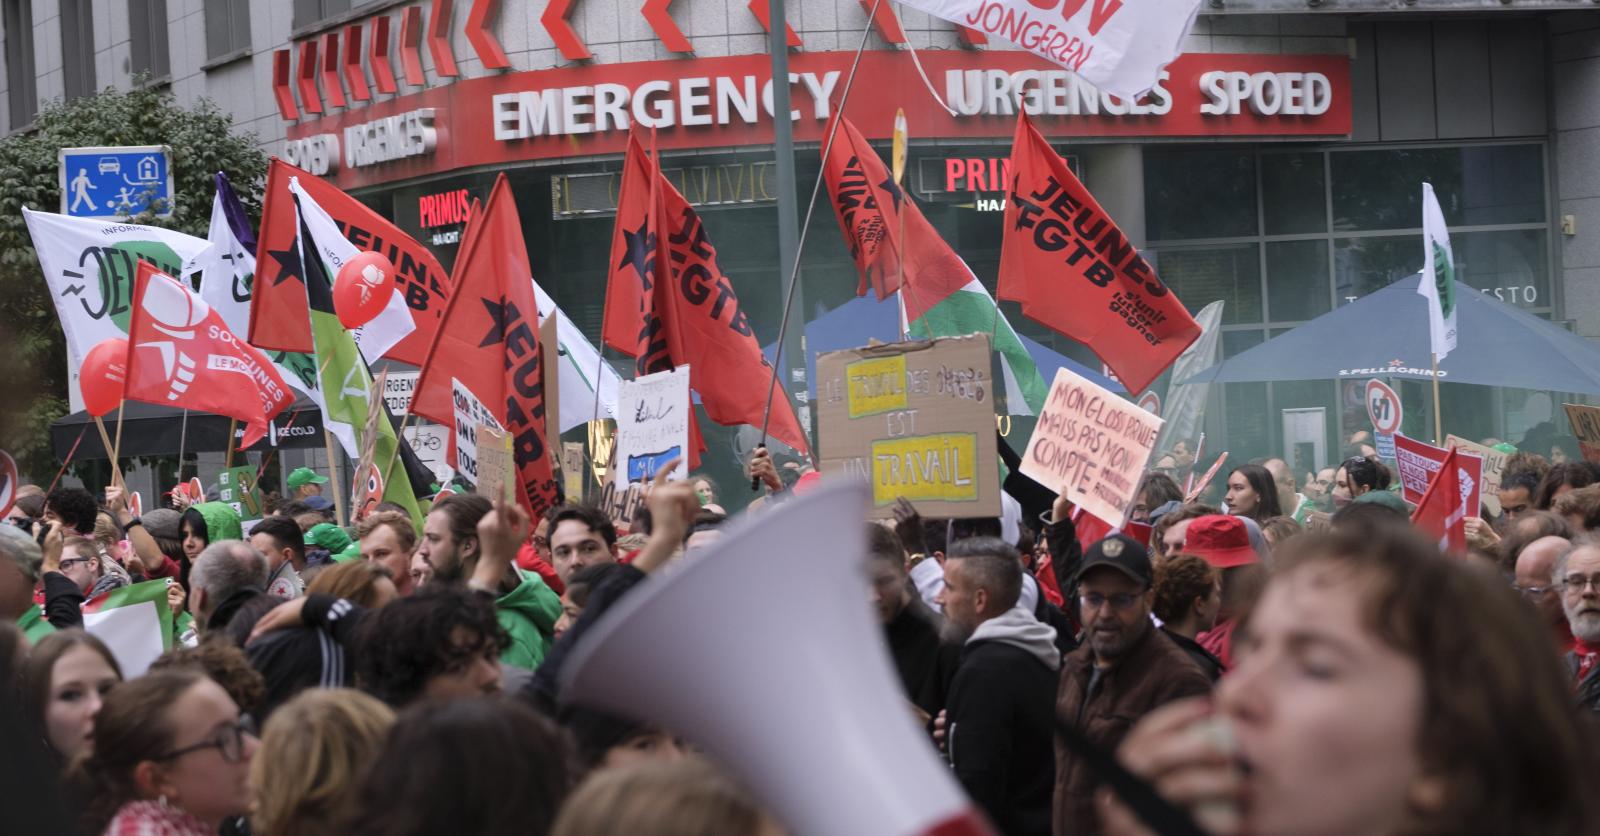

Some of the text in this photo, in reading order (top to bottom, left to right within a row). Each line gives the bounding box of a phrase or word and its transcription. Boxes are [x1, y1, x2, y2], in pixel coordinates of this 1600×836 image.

[966, 2, 1094, 73] JONGEREN
[493, 70, 841, 141] EMERGENCY
[1200, 70, 1333, 116] SPOED
[343, 107, 438, 169] URGENCES
[419, 188, 471, 229] PRIMUS
[1018, 201, 1115, 288] FGTB
[1030, 175, 1168, 298] JEUNES
[1108, 301, 1163, 347] gagner
[1111, 291, 1153, 329] lutter
[906, 369, 930, 393] DES
[277, 427, 291, 437] ICE
[290, 425, 316, 436] COLD
[886, 409, 919, 437] EST
[1052, 382, 1087, 412] MON
[1085, 395, 1128, 433] GLOSS
[1032, 437, 1097, 495] COMPTE
[1078, 425, 1105, 454] PAS
[1100, 438, 1132, 474] MON
[1403, 474, 1431, 494] PEN
